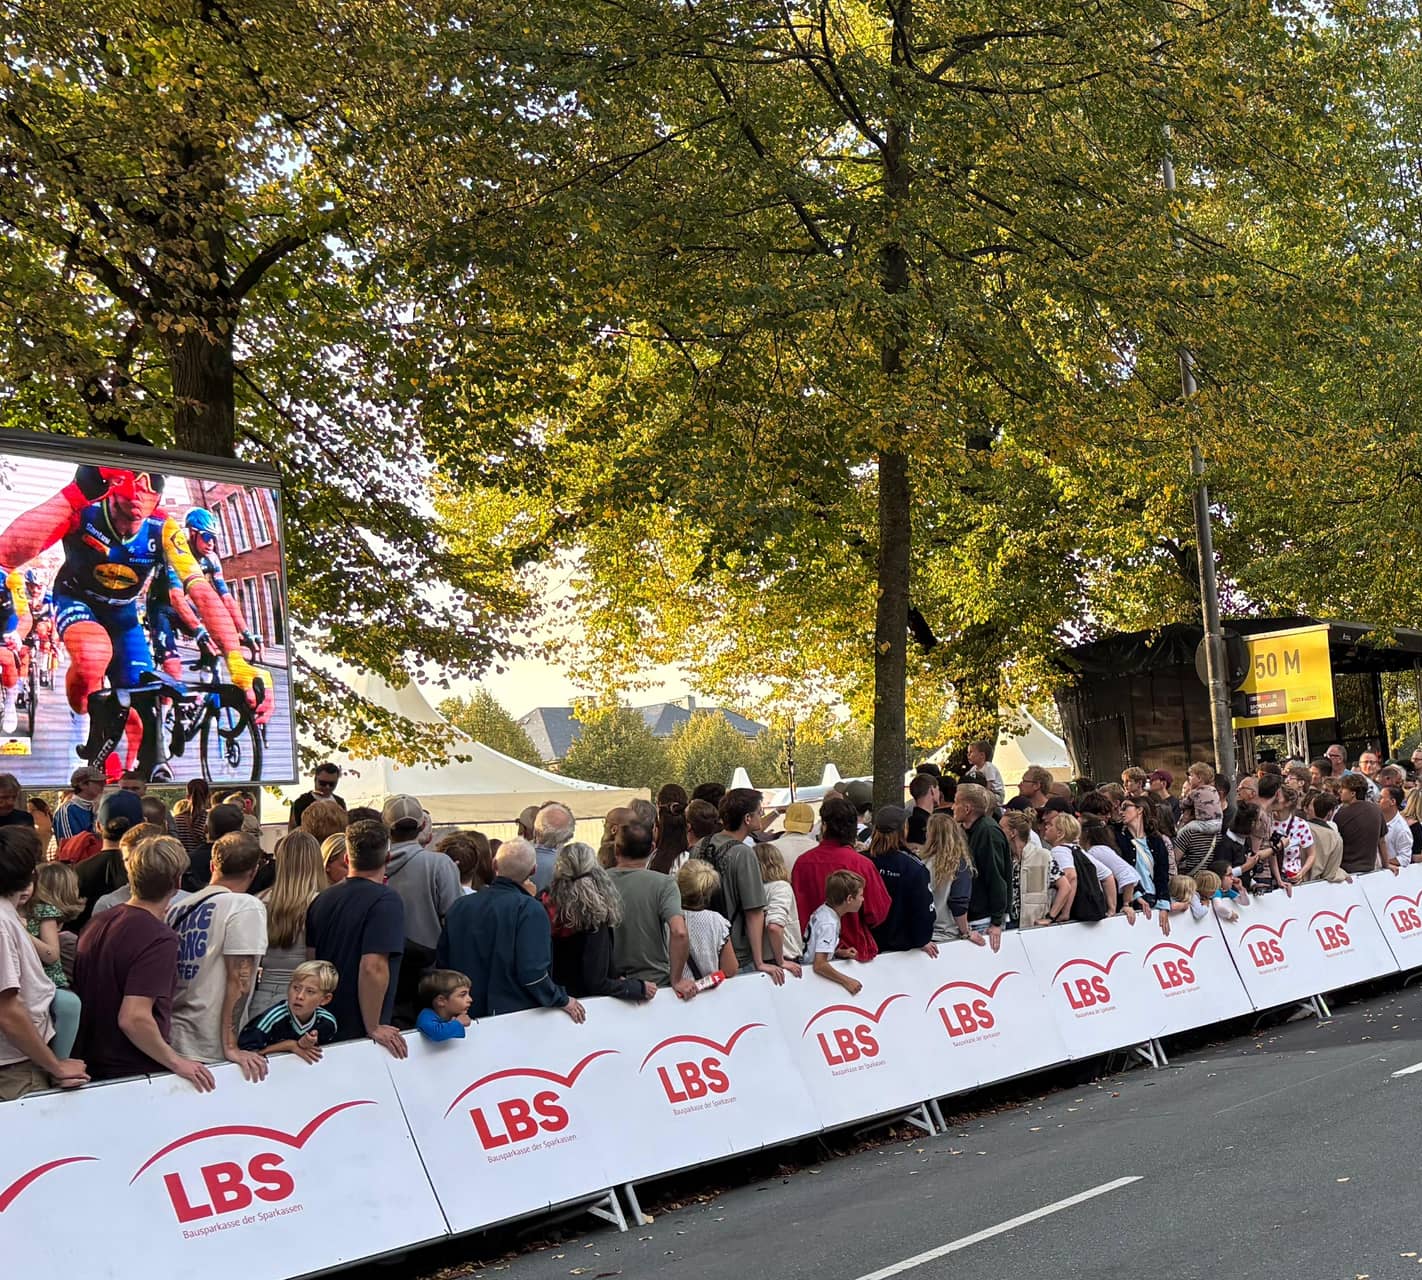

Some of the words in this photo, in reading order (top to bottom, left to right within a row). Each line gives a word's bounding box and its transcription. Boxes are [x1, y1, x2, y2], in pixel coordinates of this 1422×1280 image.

[1255, 652, 1278, 680] 50
[1284, 649, 1301, 675] M
[1391, 907, 1422, 933] LBS
[1248, 938, 1285, 967] LBS
[1316, 924, 1350, 951] LBS
[1153, 958, 1195, 989] LBS
[1063, 975, 1111, 1009] LBS
[939, 999, 995, 1038] LBS
[817, 1024, 879, 1066] LBS
[657, 1057, 730, 1103] LBS
[470, 1091, 570, 1150] LBS
[487, 1146, 531, 1164] Bausparkasse
[531, 1143, 542, 1152] der
[543, 1134, 577, 1149] Sparkassen
[163, 1152, 295, 1223] LBS
[182, 1219, 241, 1239] Bausparkasse
[242, 1215, 256, 1225] der
[257, 1204, 304, 1222] Sparkassen
